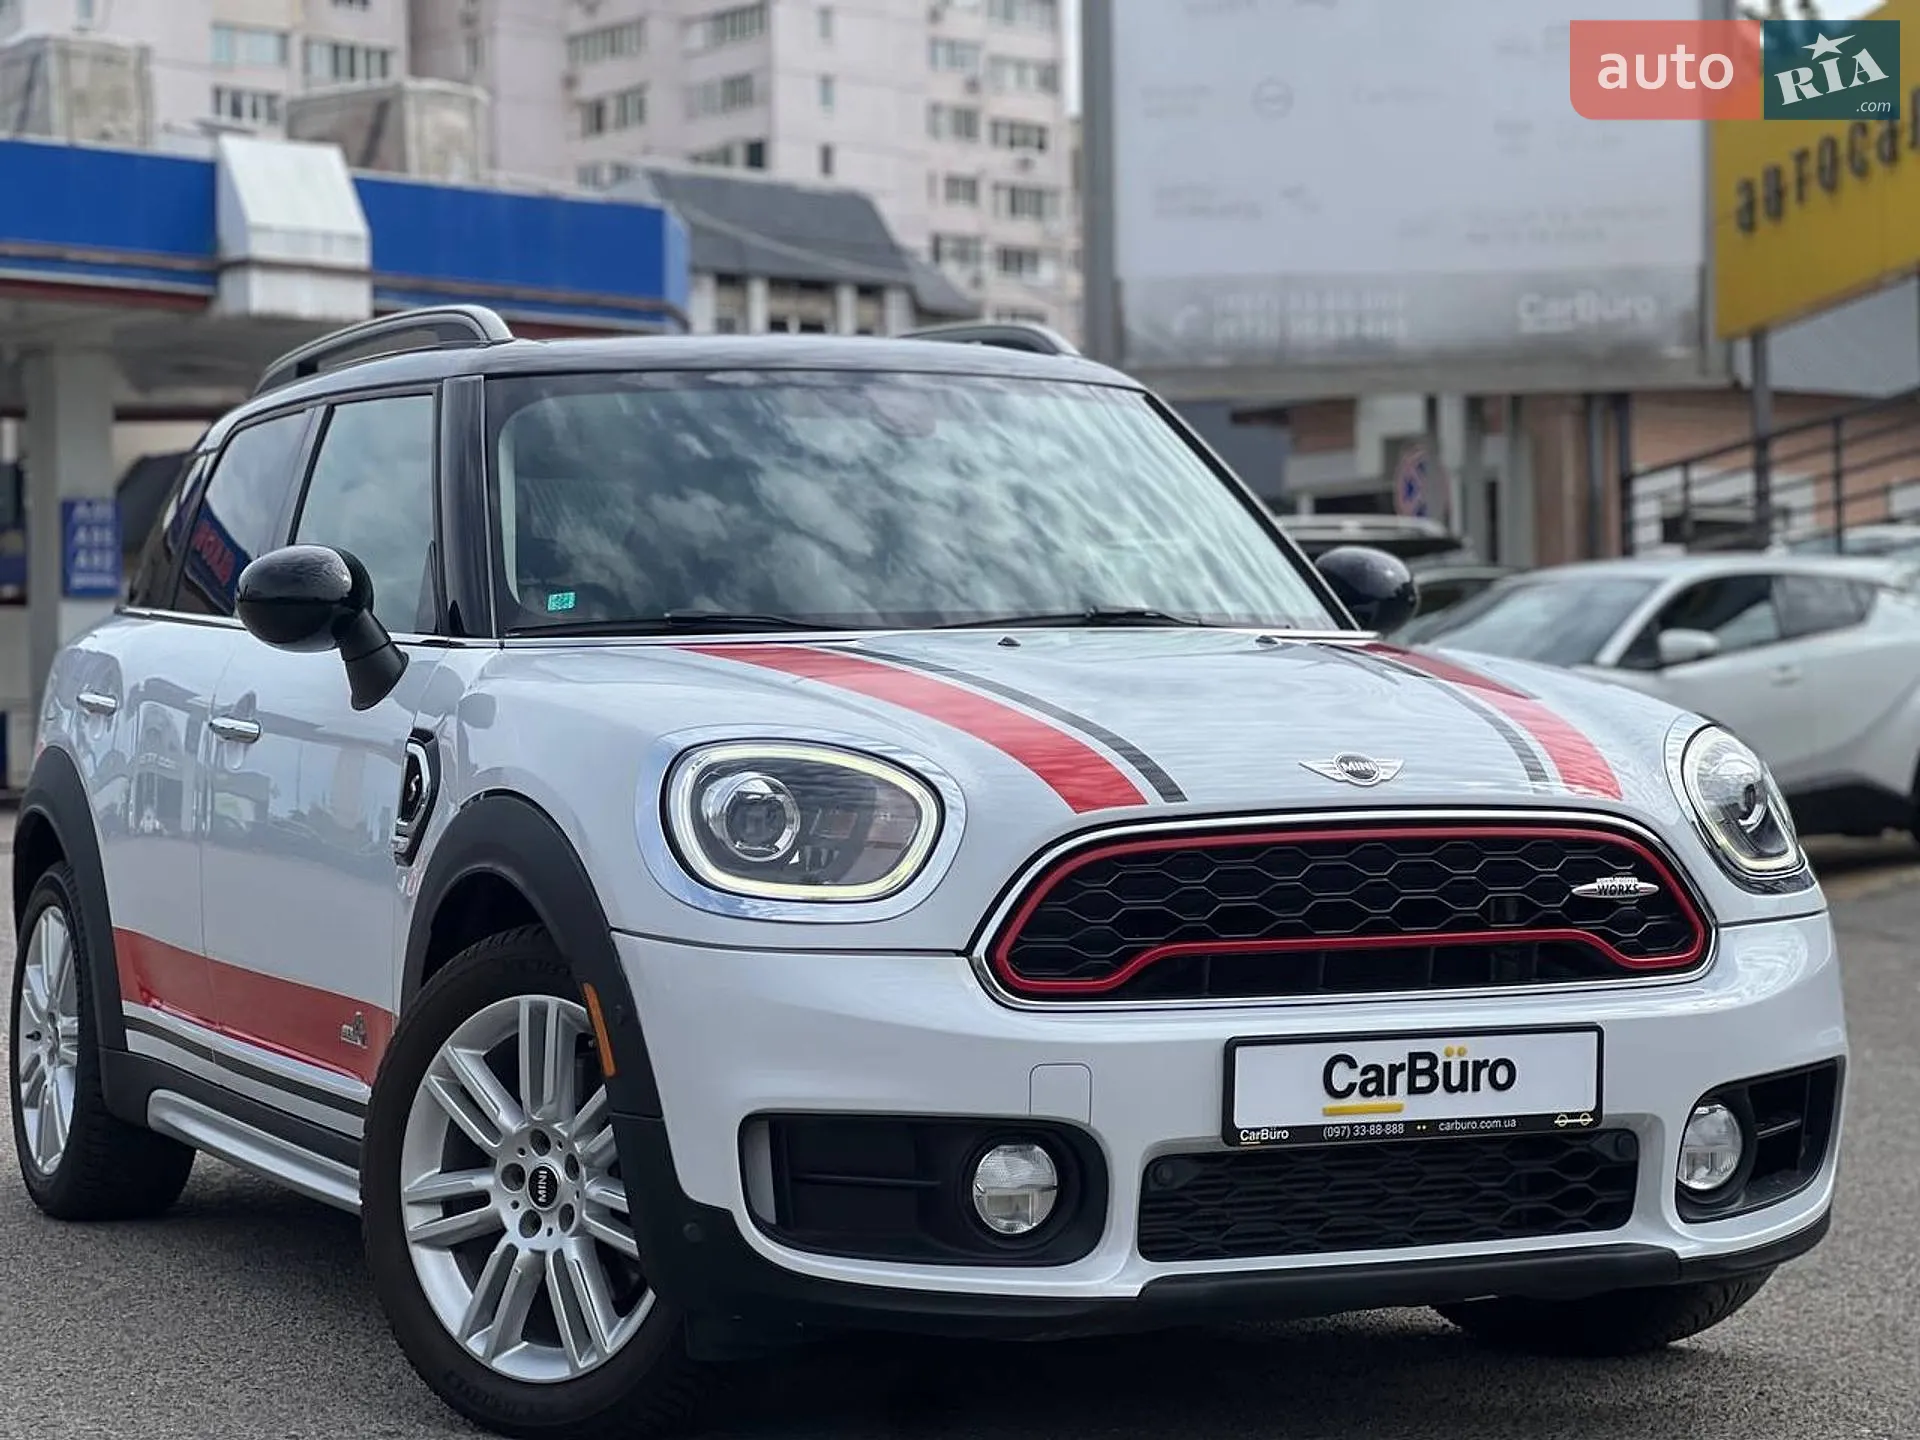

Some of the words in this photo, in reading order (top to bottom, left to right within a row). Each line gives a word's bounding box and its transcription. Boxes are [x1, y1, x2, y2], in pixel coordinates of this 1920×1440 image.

[1341, 761, 1376, 771] MINI
[1596, 884, 1640, 896] WORKS
[1322, 1045, 1517, 1099] CarBüro
[1323, 1124, 1350, 1139] (097)
[1352, 1123, 1405, 1137] 33-88-888
[1439, 1117, 1517, 1131] carburo.com.ua
[538, 1170, 548, 1203] MINI
